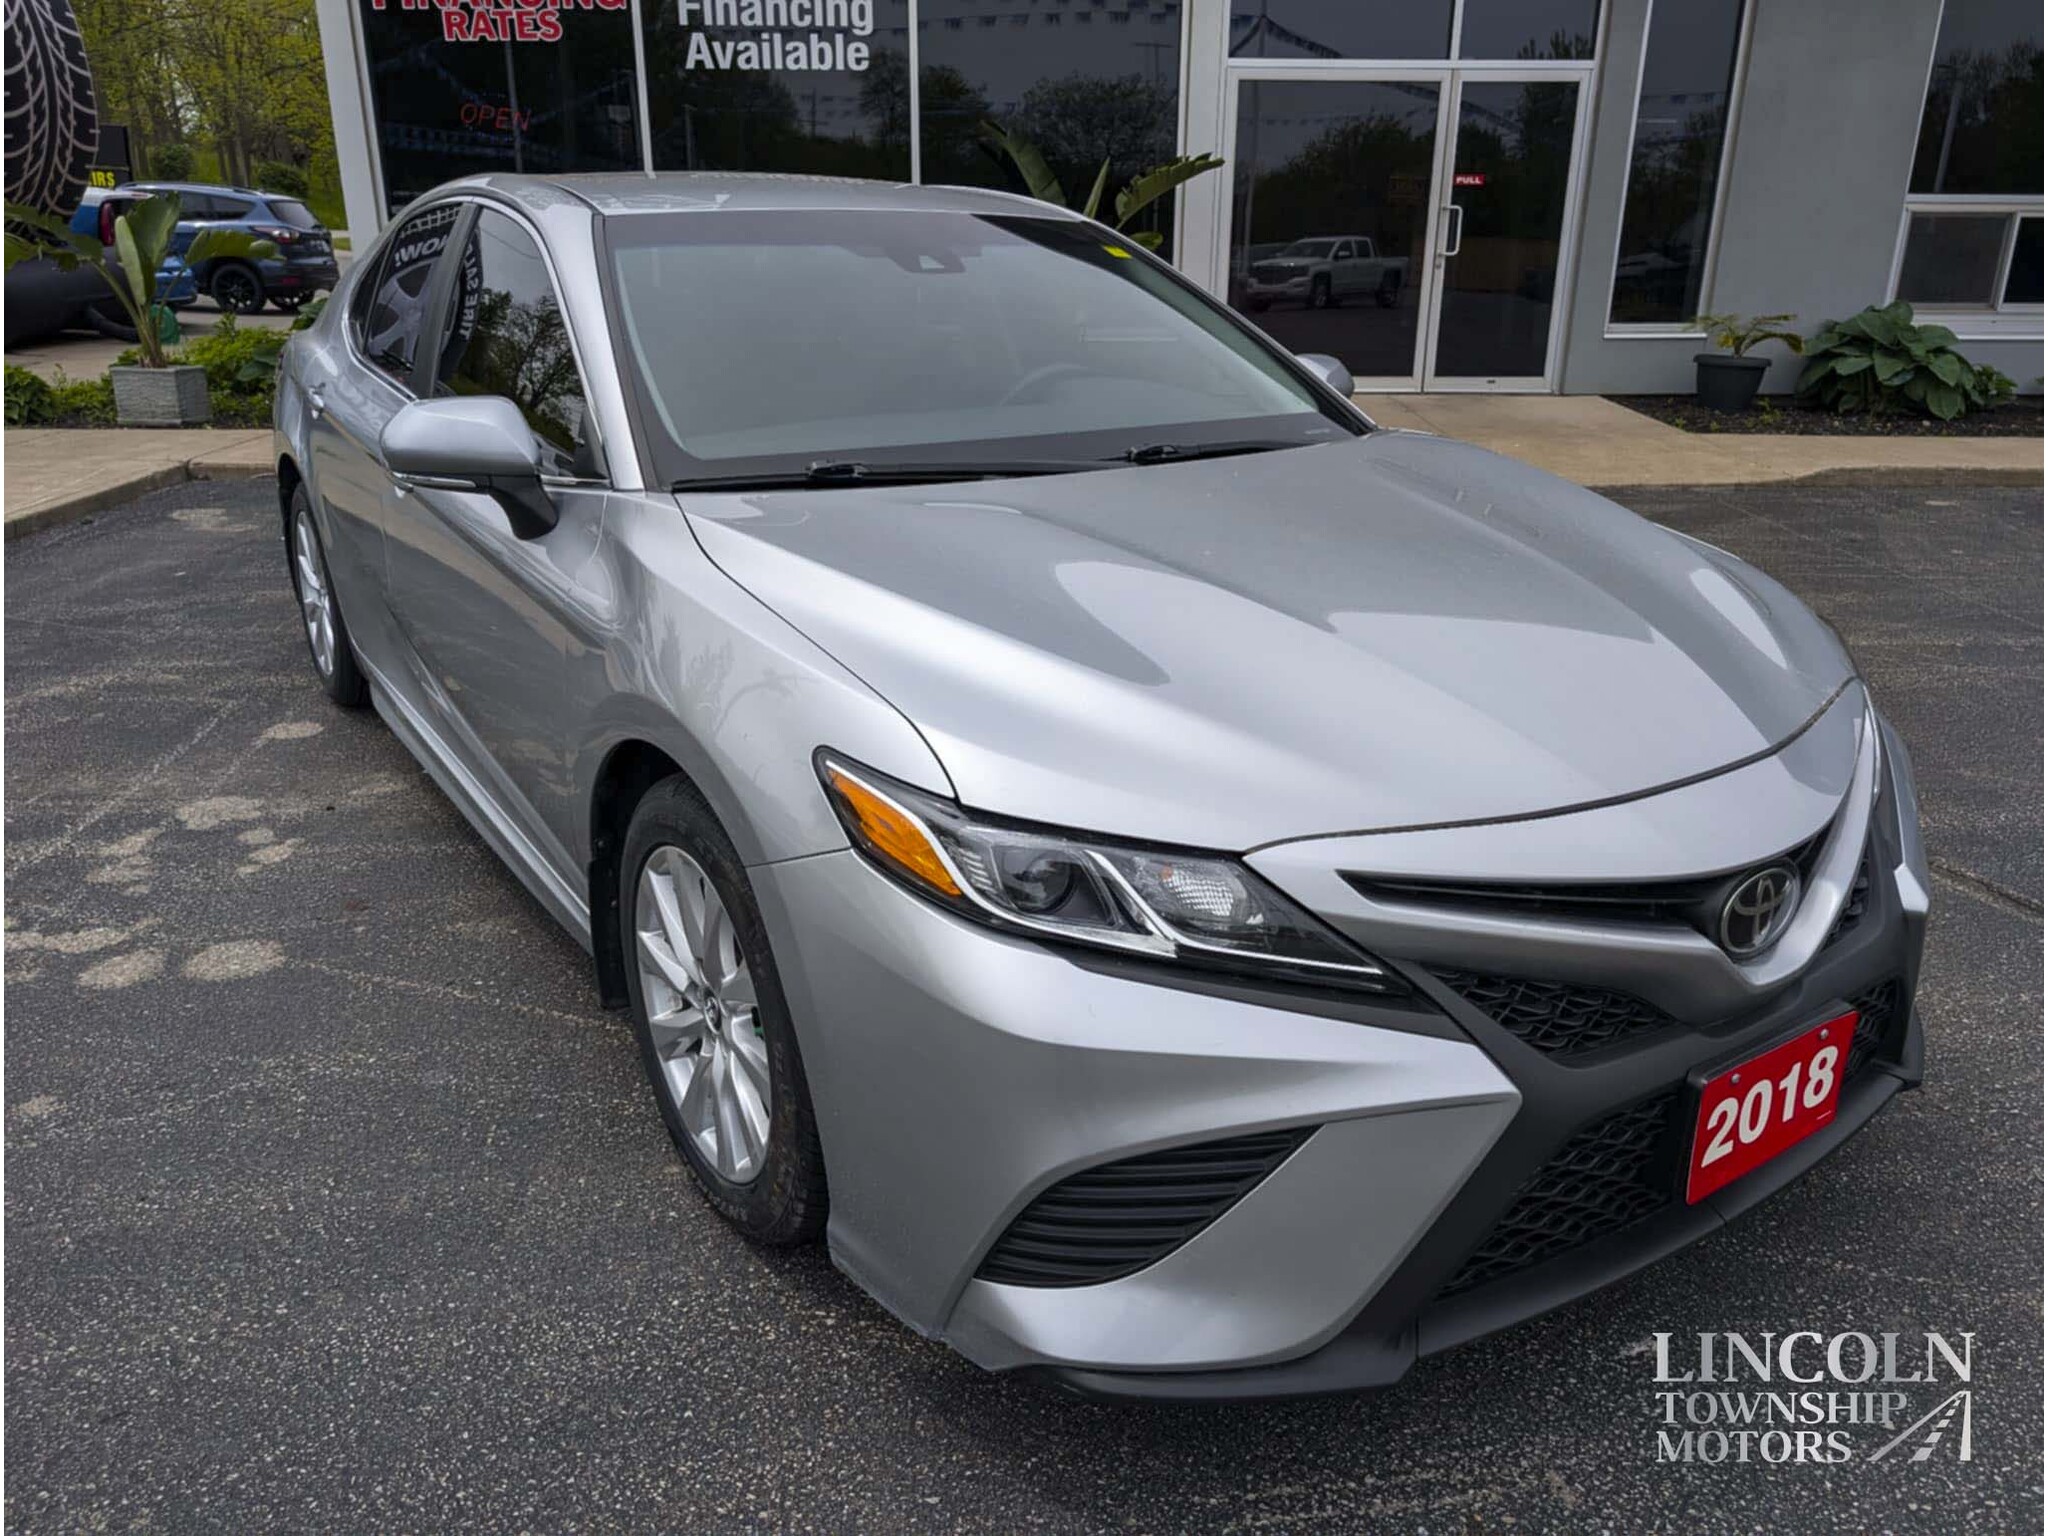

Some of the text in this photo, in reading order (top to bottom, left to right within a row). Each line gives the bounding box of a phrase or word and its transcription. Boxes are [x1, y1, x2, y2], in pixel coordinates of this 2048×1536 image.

[442, 9, 564, 42] RATES
[678, 0, 875, 36] Financing
[685, 32, 870, 71] Available
[460, 103, 532, 131] OPEN
[89, 171, 116, 187] IRS
[1456, 176, 1482, 185] PULL
[1701, 1045, 1839, 1168] 2018
